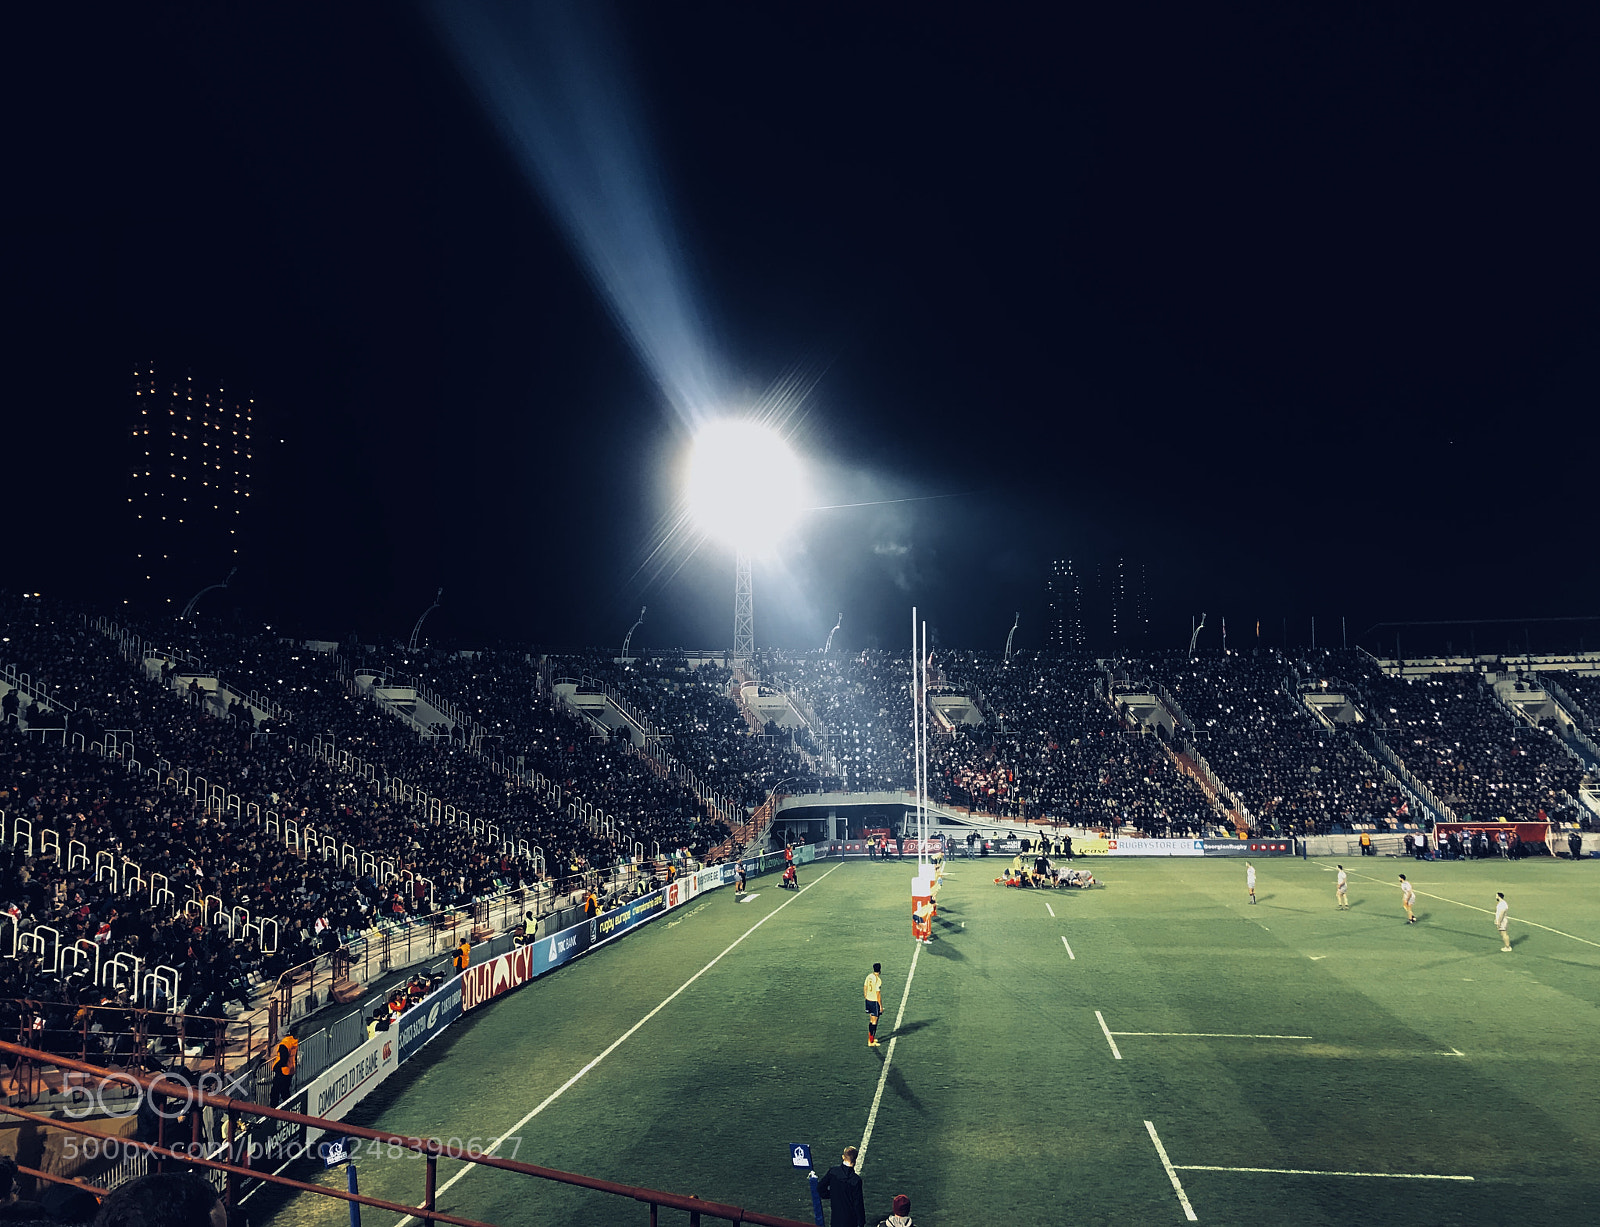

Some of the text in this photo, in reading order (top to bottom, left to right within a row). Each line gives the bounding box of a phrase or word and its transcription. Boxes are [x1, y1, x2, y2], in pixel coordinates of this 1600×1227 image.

[599, 917, 615, 934] rugby
[566, 934, 577, 950] BANK
[510, 945, 533, 989] ICY
[318, 1073, 349, 1116] COMMITTED
[348, 1067, 356, 1090] TO
[355, 1059, 365, 1085] THE
[365, 1049, 379, 1077] GAME
